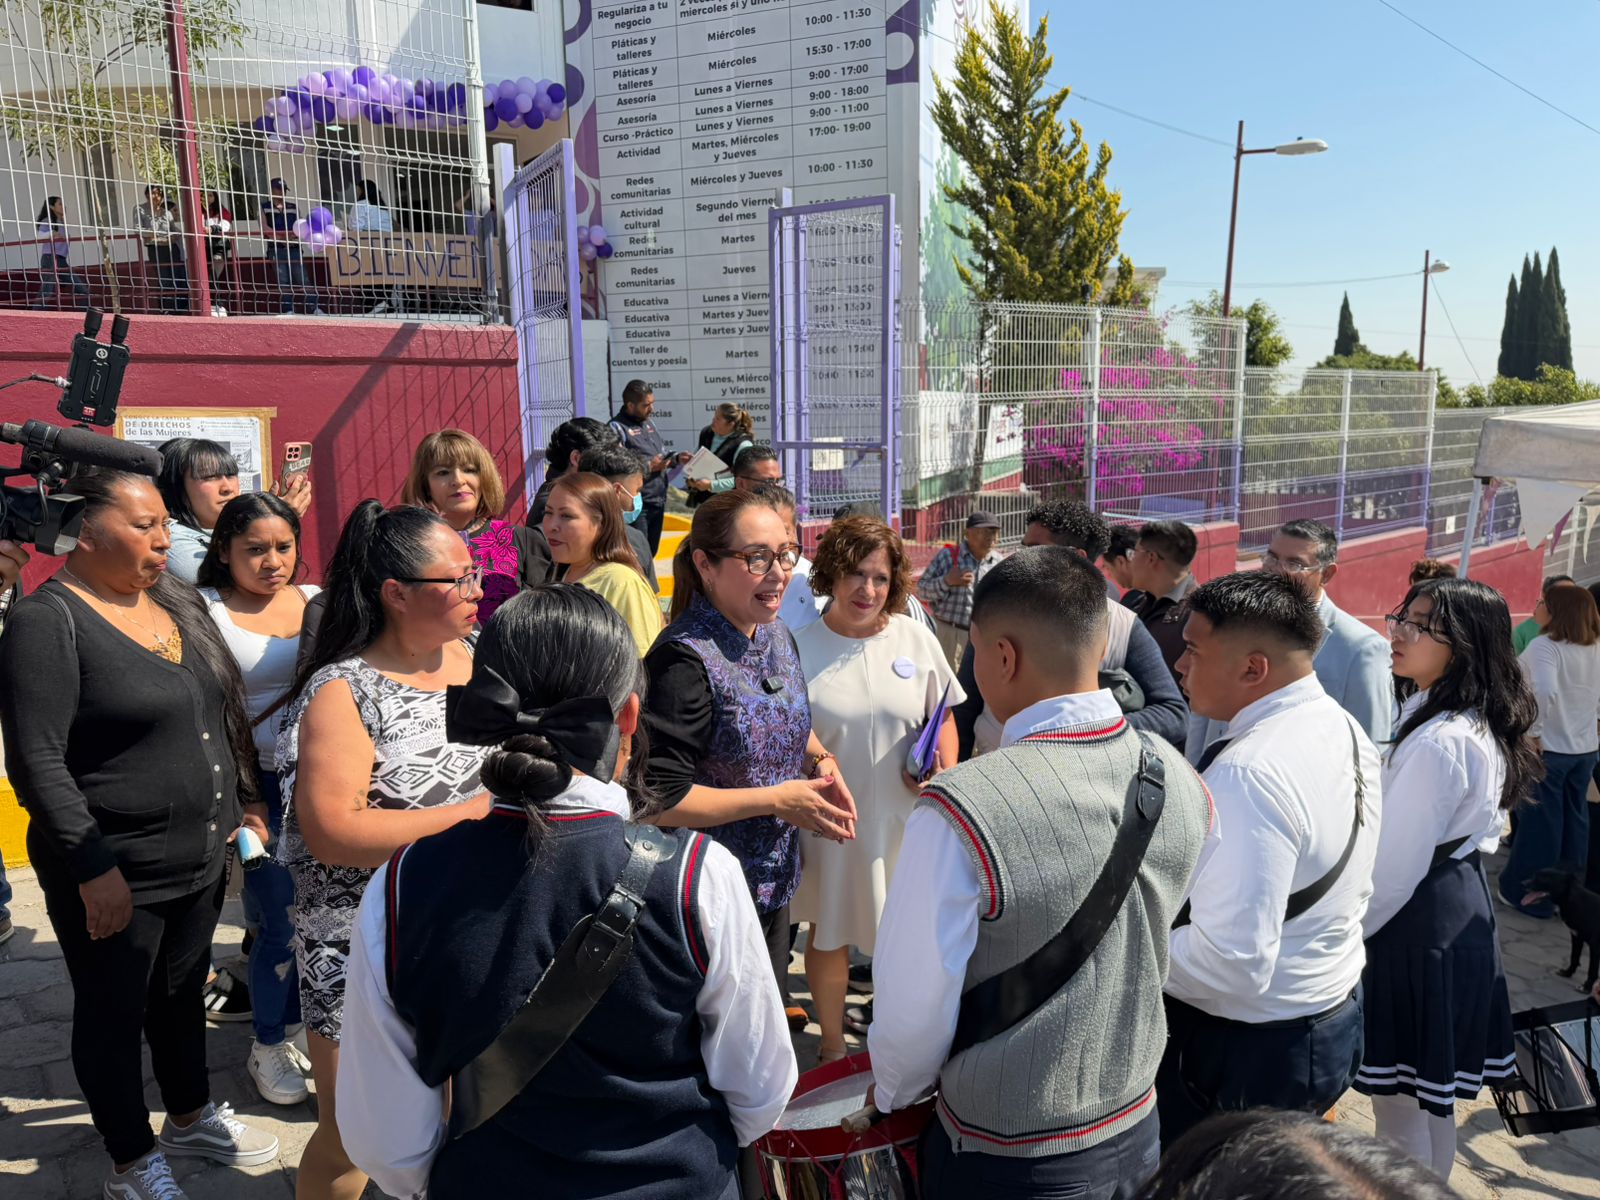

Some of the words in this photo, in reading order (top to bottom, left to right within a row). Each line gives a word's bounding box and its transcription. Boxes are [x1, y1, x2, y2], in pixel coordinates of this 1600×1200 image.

[598, 5, 647, 20] Regulariza
[657, 1, 668, 10] tu
[680, 4, 728, 18] miercoles
[805, 13, 833, 26] 10:00
[843, 7, 872, 20] 11:30
[614, 16, 652, 29] negocio
[707, 26, 756, 42] Miércoles
[611, 36, 648, 49] Pláticas
[650, 36, 657, 45] y
[806, 44, 833, 56] 15:30
[844, 38, 872, 51] 17:00
[616, 49, 652, 61] talleres
[708, 55, 757, 71] Miércoles
[613, 66, 649, 79] Pláticas
[651, 66, 658, 75] y
[809, 69, 831, 80] 9:00
[841, 64, 869, 76] 17:00
[618, 80, 654, 91] talleres
[694, 85, 724, 96] Lunes
[734, 78, 773, 90] Viernes
[809, 90, 831, 101] 9:00
[841, 85, 869, 96] 18:00
[616, 93, 657, 106] Asesoría
[695, 104, 724, 116] Lunes
[726, 104, 732, 112] a
[735, 98, 774, 110] Viernes
[809, 107, 831, 118] 9:00
[841, 102, 869, 114] 11:00
[617, 112, 657, 125] Asesoría
[695, 121, 724, 132] Lunes
[726, 121, 733, 130] y
[735, 115, 774, 127] Viernes
[843, 121, 871, 133] 19:00
[602, 133, 629, 143] Curso
[730, 133, 779, 146] Miércoles
[616, 146, 661, 159] Actividad
[713, 153, 720, 163] y
[722, 149, 757, 160] Jueves
[808, 162, 835, 174] 10:00
[845, 159, 873, 170] 11:30
[626, 176, 654, 187] Redes
[690, 173, 737, 186] Miércoles
[739, 173, 746, 183] y
[748, 169, 783, 180] Jueves
[610, 187, 672, 200] comunitarias
[620, 206, 664, 219] Actividad
[696, 200, 739, 213] Segundo
[718, 212, 734, 222] del
[736, 212, 757, 220] mes
[624, 219, 660, 230] cultural
[721, 235, 756, 245] Martes
[614, 246, 674, 258] comunitarias
[631, 266, 659, 276] Redes
[722, 265, 756, 275] Jueves
[615, 277, 676, 289] comunitarias
[624, 297, 669, 307] Educativa
[702, 294, 731, 303] Lunes
[741, 291, 770, 300] Viern
[624, 313, 670, 323] Educativa
[702, 311, 735, 320] Martes
[737, 311, 744, 320] y
[746, 309, 769, 317] Juev
[625, 329, 671, 339] Educativa
[703, 327, 736, 336] Martes
[738, 327, 745, 336] y
[746, 324, 770, 333] Juev
[629, 346, 655, 355] Taller
[656, 345, 669, 354] de
[725, 350, 759, 359] Martes
[611, 359, 648, 367] cuentos
[649, 359, 656, 368] y
[736, 373, 771, 383] Miércol
[721, 388, 728, 397] y
[729, 386, 766, 395] Viernes
[738, 401, 770, 411] Miérco
[125, 420, 137, 428] DE
[141, 421, 191, 429] DERECHOS
[125, 428, 137, 436] de
[140, 428, 153, 436] las
[156, 429, 192, 437] Mujeres
